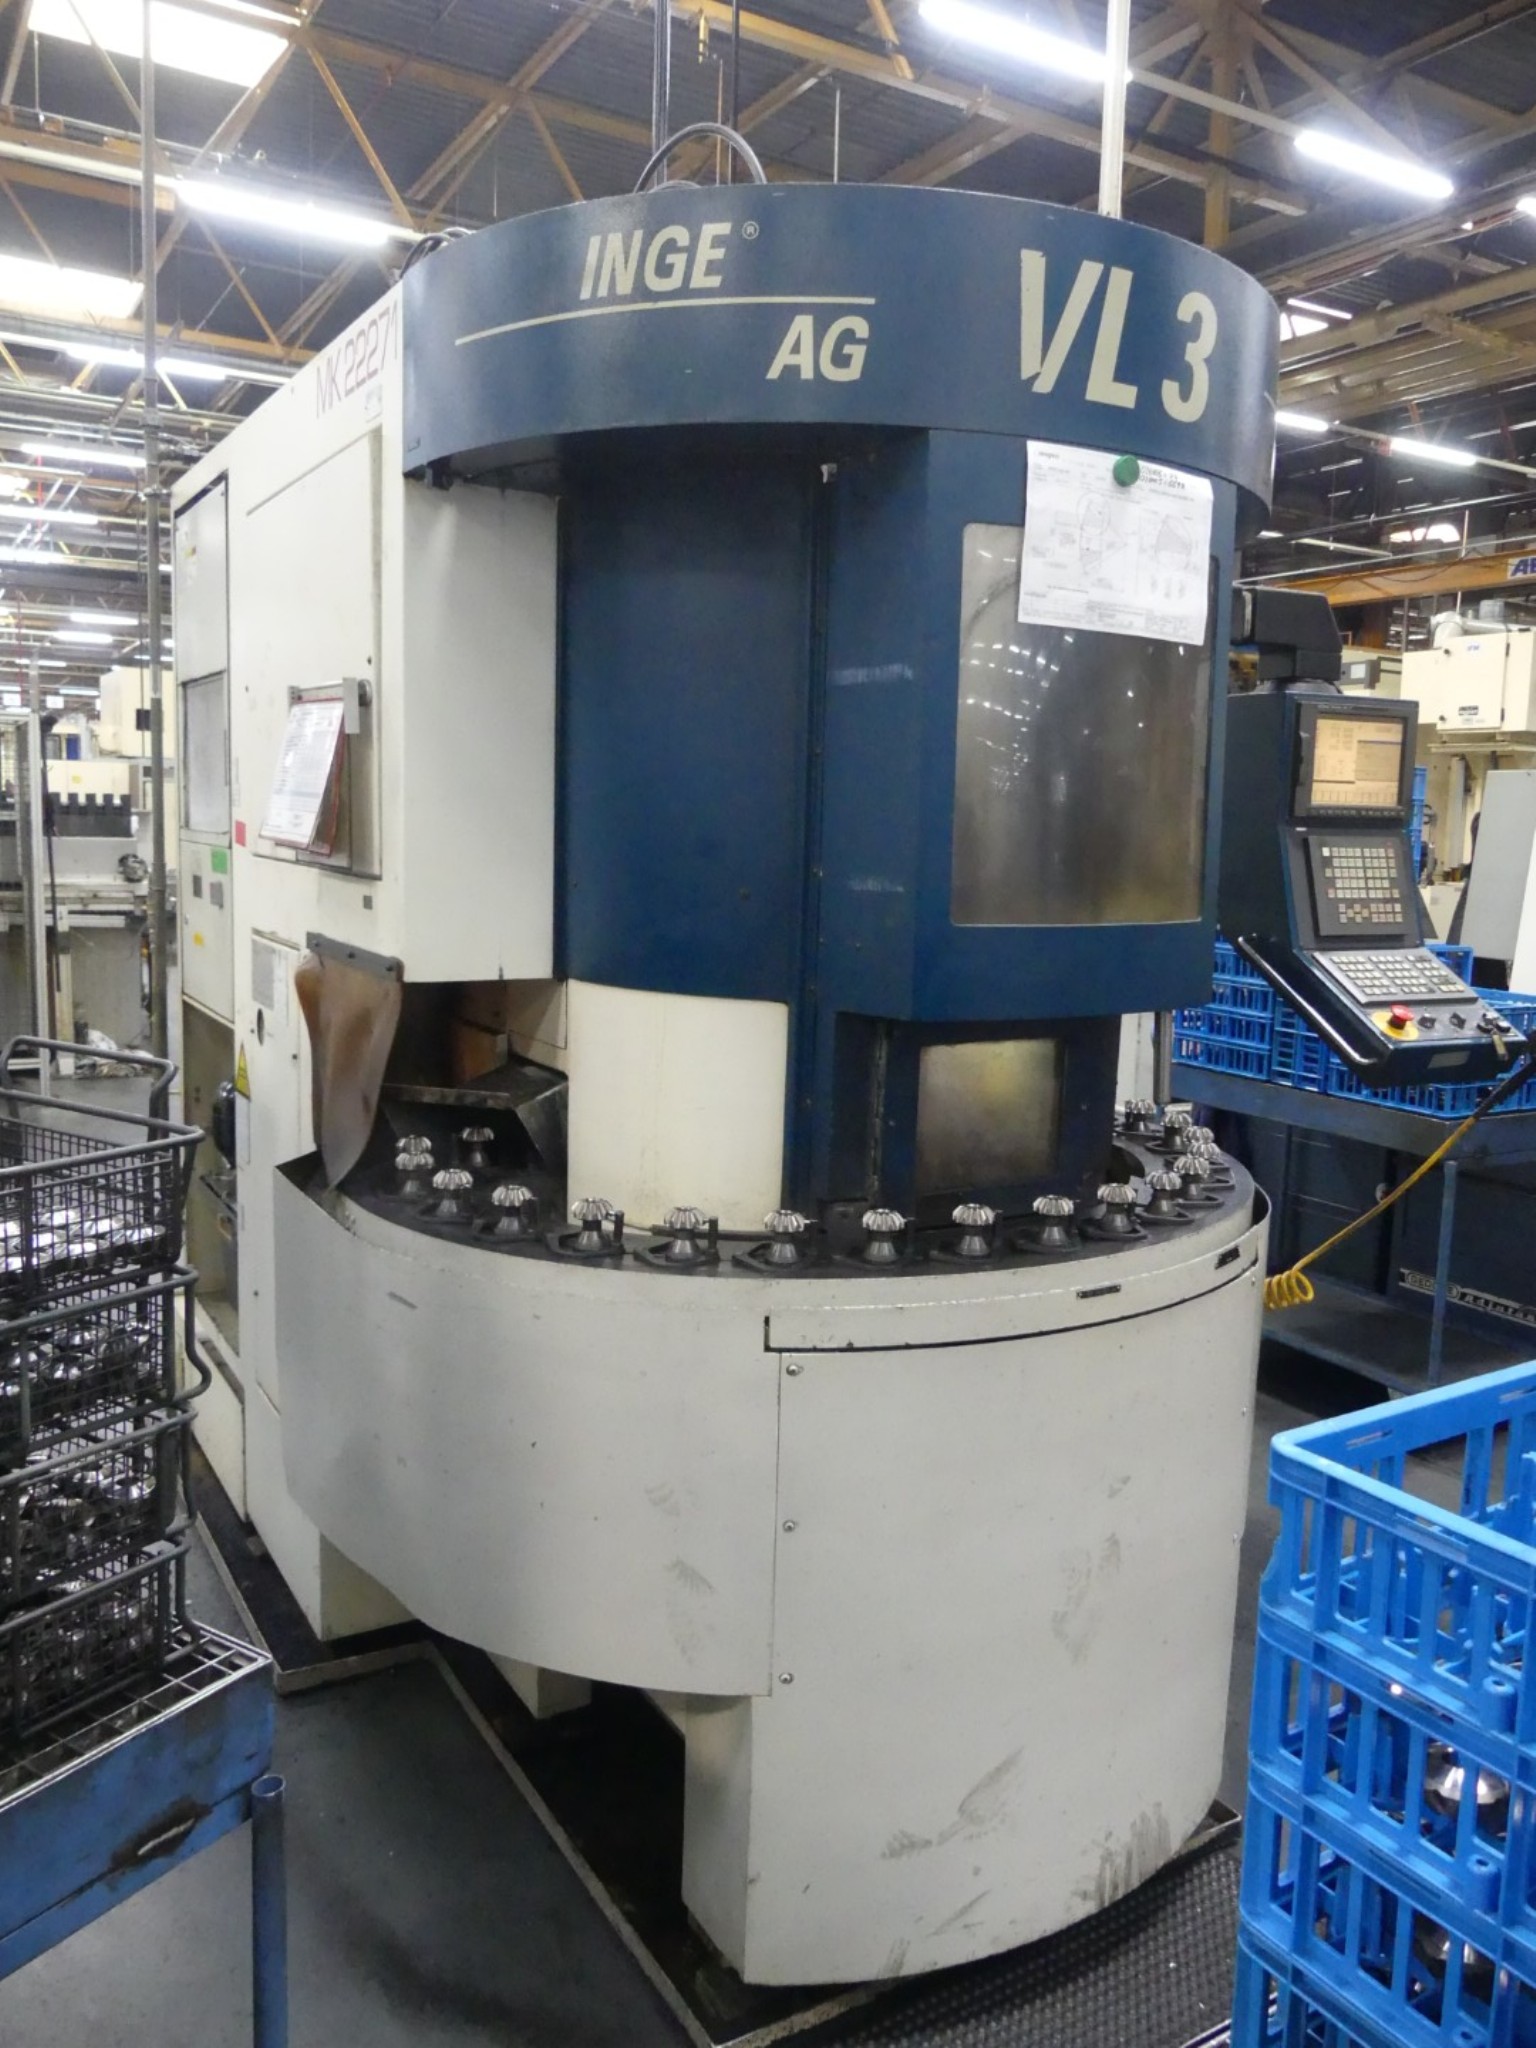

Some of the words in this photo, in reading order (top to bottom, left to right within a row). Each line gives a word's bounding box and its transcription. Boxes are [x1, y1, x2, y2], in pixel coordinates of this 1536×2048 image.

[579, 222, 732, 300] INGE
[766, 314, 870, 382] AG
[1161, 291, 1218, 423] 3
